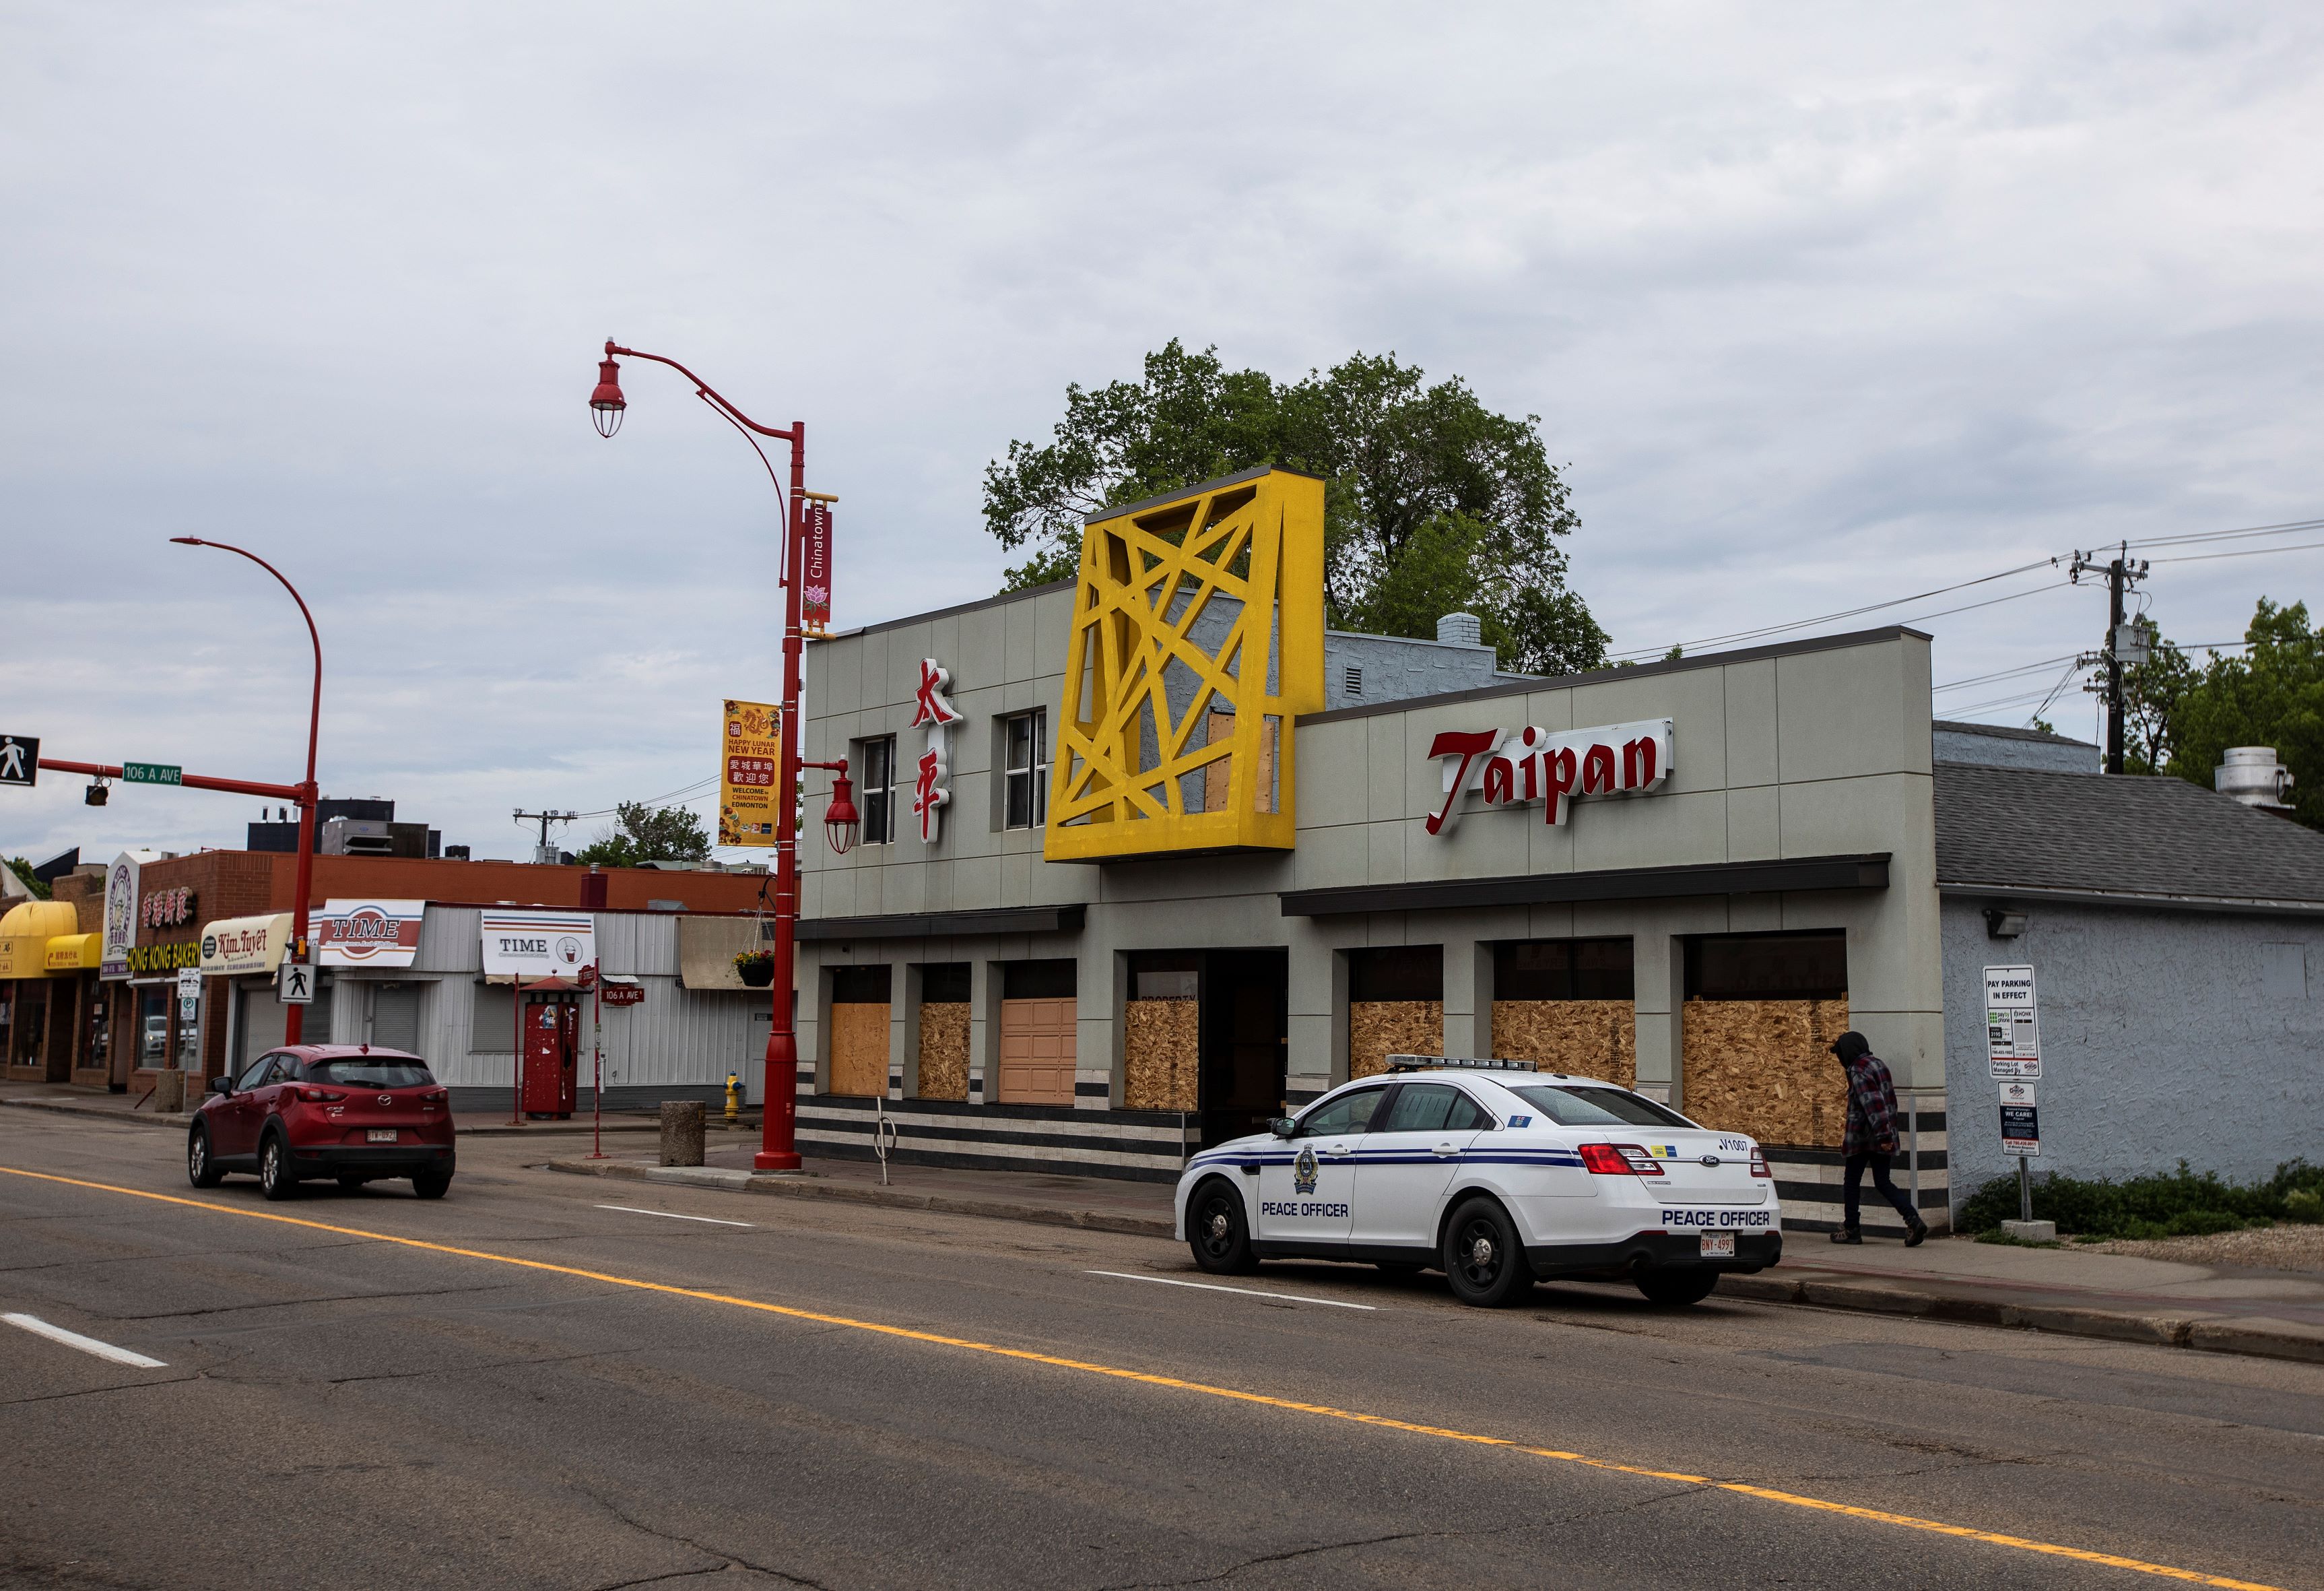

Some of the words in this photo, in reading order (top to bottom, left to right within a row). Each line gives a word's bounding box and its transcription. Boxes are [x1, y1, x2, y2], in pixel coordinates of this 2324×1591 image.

[811, 507, 823, 578] Chinatown
[729, 723, 741, 735] 福
[728, 745, 749, 754] NEW
[751, 747, 775, 755] YEAR
[730, 760, 773, 771] 愛城華埠
[126, 766, 144, 779] 106
[148, 768, 156, 780] A
[160, 769, 180, 782] AVE
[733, 772, 769, 783] 歡迎您
[1425, 725, 1662, 835] Taipan
[333, 919, 400, 938] TIME
[218, 932, 240, 959] Kim
[500, 939, 547, 952] TIME
[126, 947, 147, 971] HONG
[150, 944, 170, 970] KONG
[173, 942, 201, 968] BAKERY
[1720, 1139, 1748, 1151] V1007
[1262, 1202, 1298, 1216] PEACE
[1301, 1203, 1348, 1217] OFFICER
[1662, 1210, 1715, 1226] PEACE
[1720, 1211, 1770, 1226] OFFICER
[1702, 1239, 1733, 1250] BNY-4997
